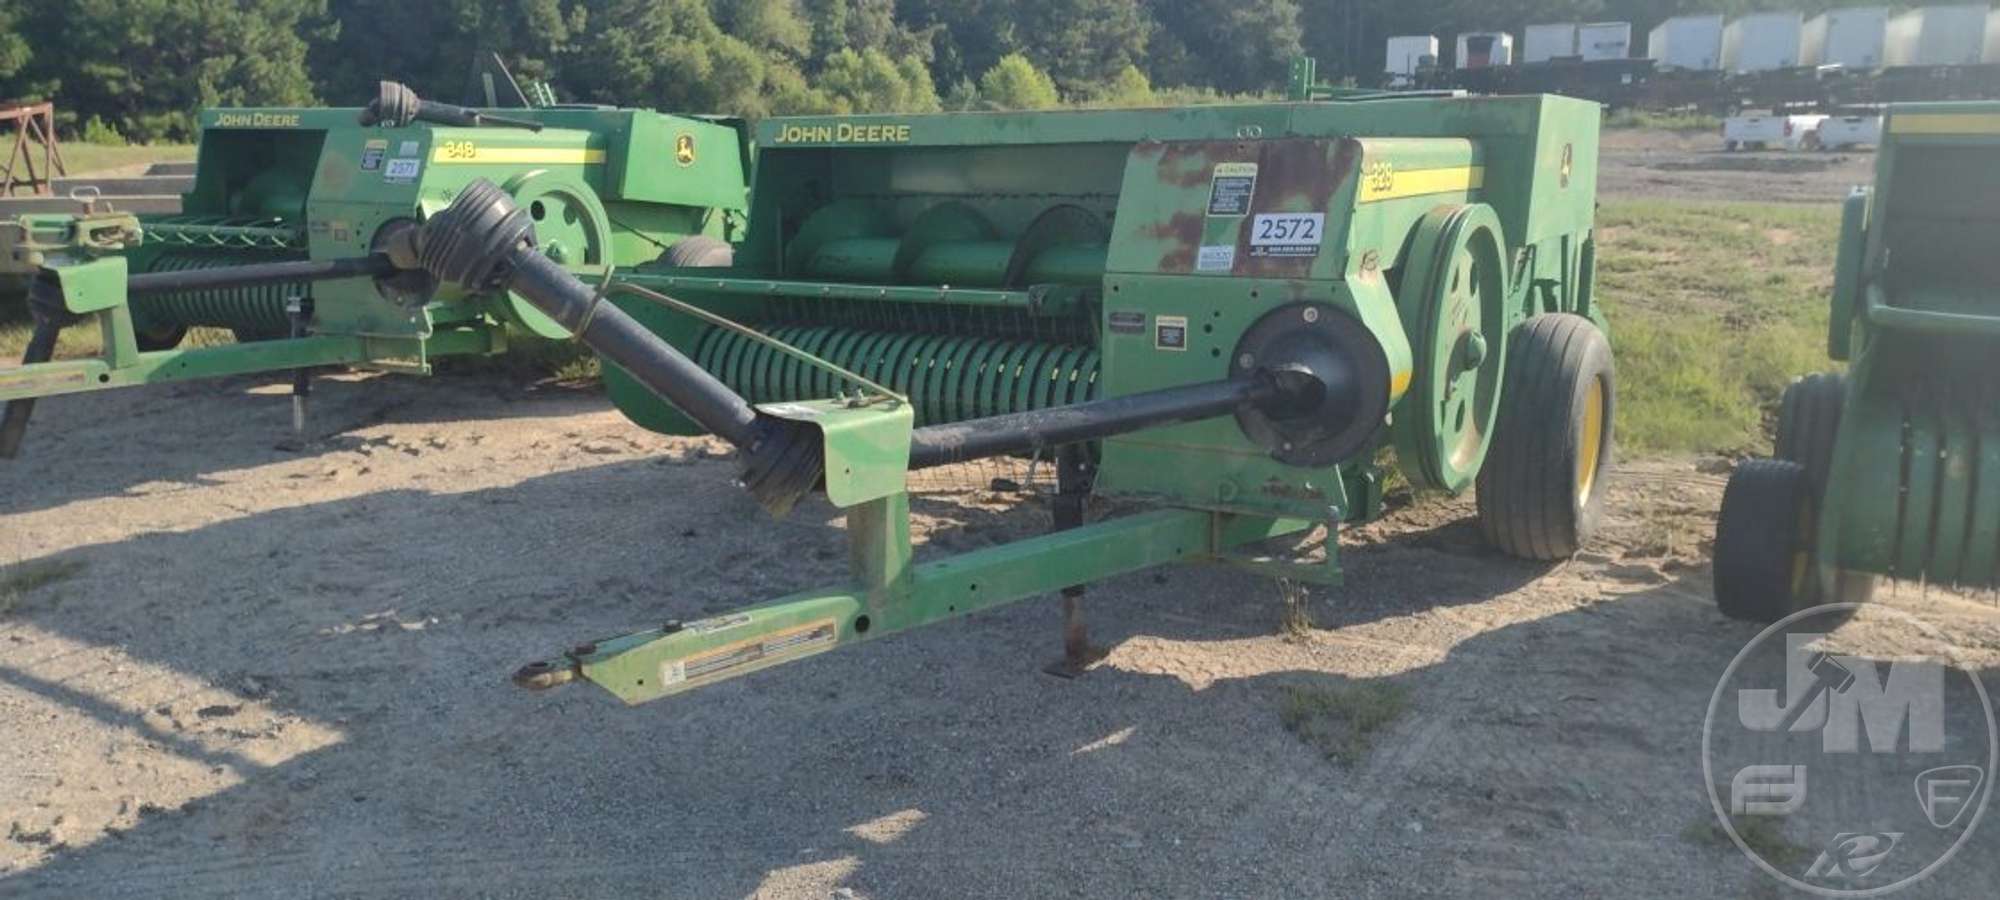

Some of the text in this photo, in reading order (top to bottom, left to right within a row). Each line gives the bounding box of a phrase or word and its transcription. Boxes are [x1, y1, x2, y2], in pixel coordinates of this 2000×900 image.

[214, 112, 300, 127] JOHN DEERE
[775, 122, 911, 143] JOHN DEERE
[446, 141, 475, 158] 348
[1259, 218, 1316, 240] 2572
